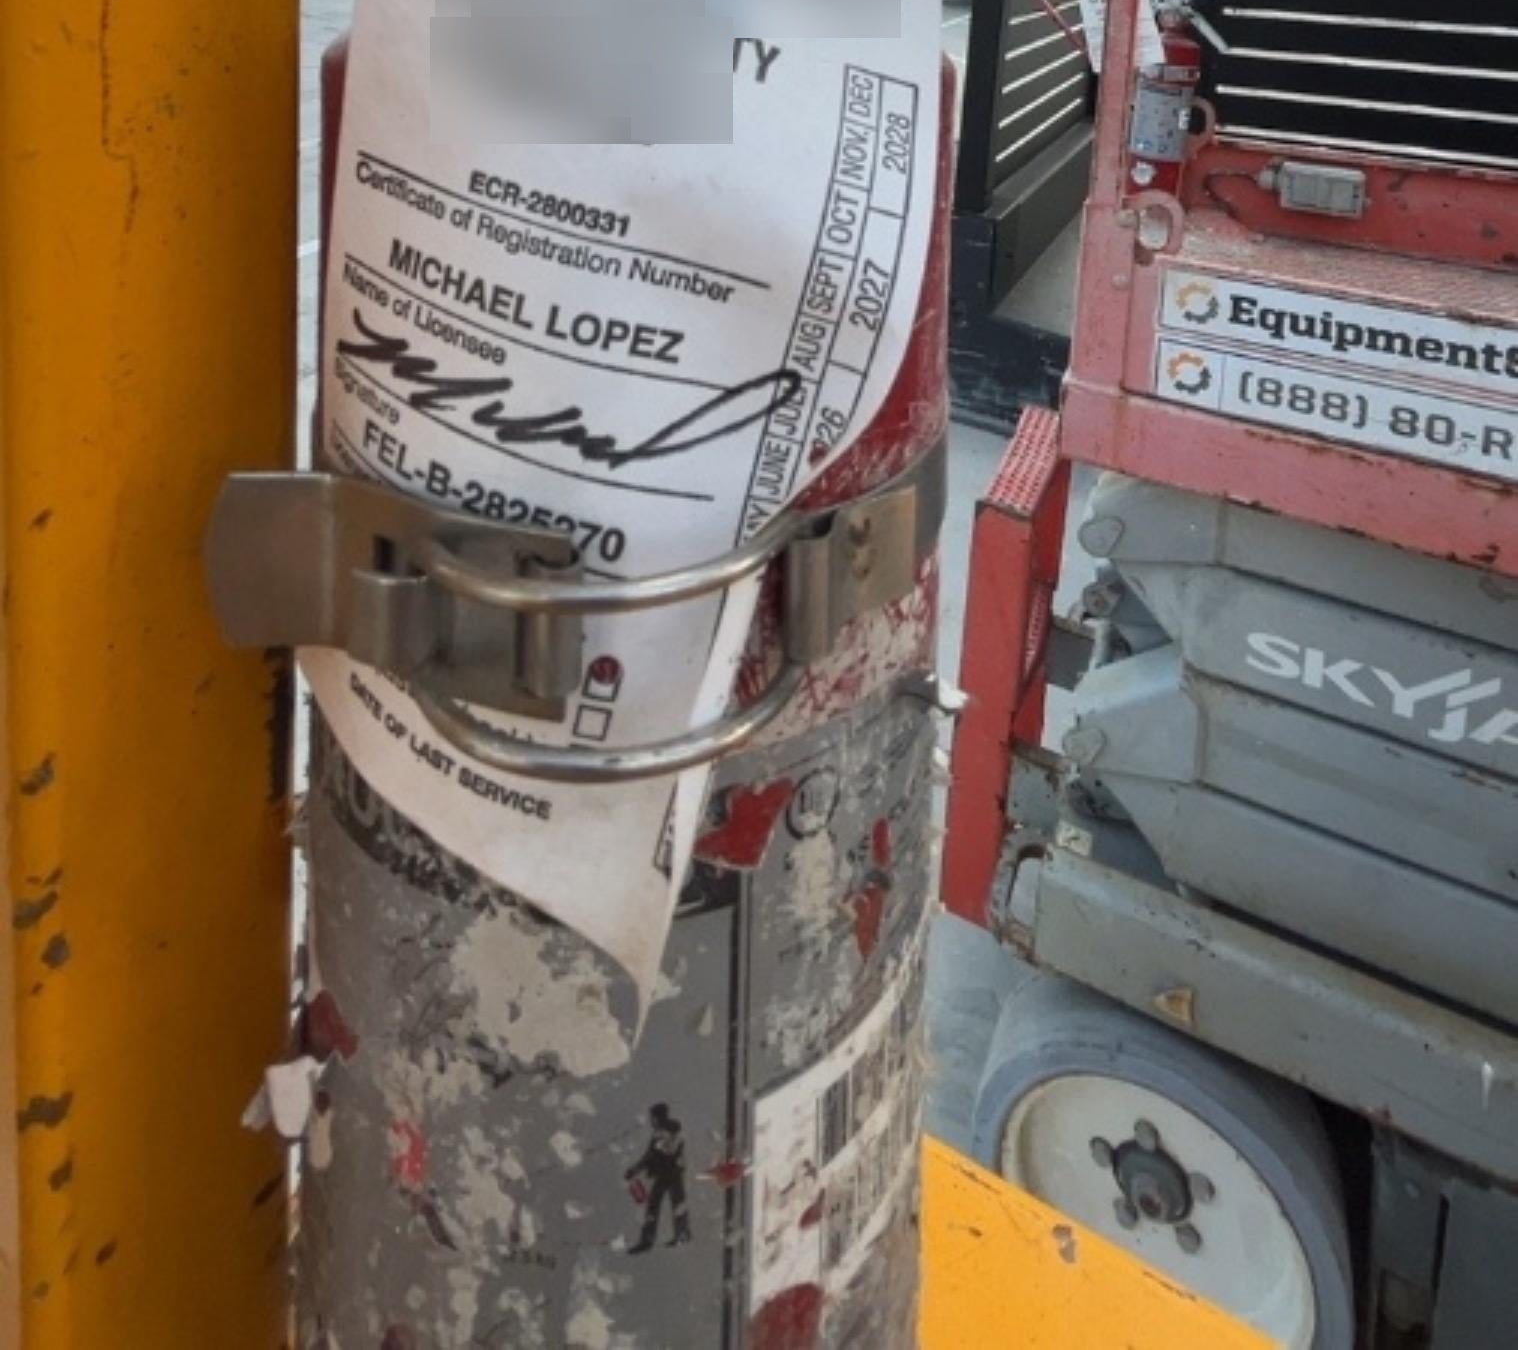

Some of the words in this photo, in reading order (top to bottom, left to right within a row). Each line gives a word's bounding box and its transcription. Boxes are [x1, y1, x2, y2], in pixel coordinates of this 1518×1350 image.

[882, 112, 912, 174] 2028
[356, 160, 445, 220] Certificate
[450, 208, 474, 232] of
[476, 213, 621, 277] Registration
[627, 258, 736, 304] Number
[468, 169, 632, 238] ECR-2800331
[827, 192, 862, 247] OCT
[343, 262, 389, 307] Name
[392, 300, 412, 320] of
[413, 305, 507, 366] Licensee
[388, 236, 534, 330] MICHAEL
[545, 305, 685, 364] LOPEZ
[806, 256, 845, 316] SEPT
[848, 258, 893, 332] 2027
[790, 322, 827, 373] AUG
[1238, 370, 1370, 430] (888)
[1388, 405, 1514, 461] 80-R
[756, 440, 792, 496] JUNE
[350, 670, 384, 722] DATE
[384, 712, 409, 740] OF
[409, 733, 457, 777] LAST
[458, 765, 554, 823] SERVICE
